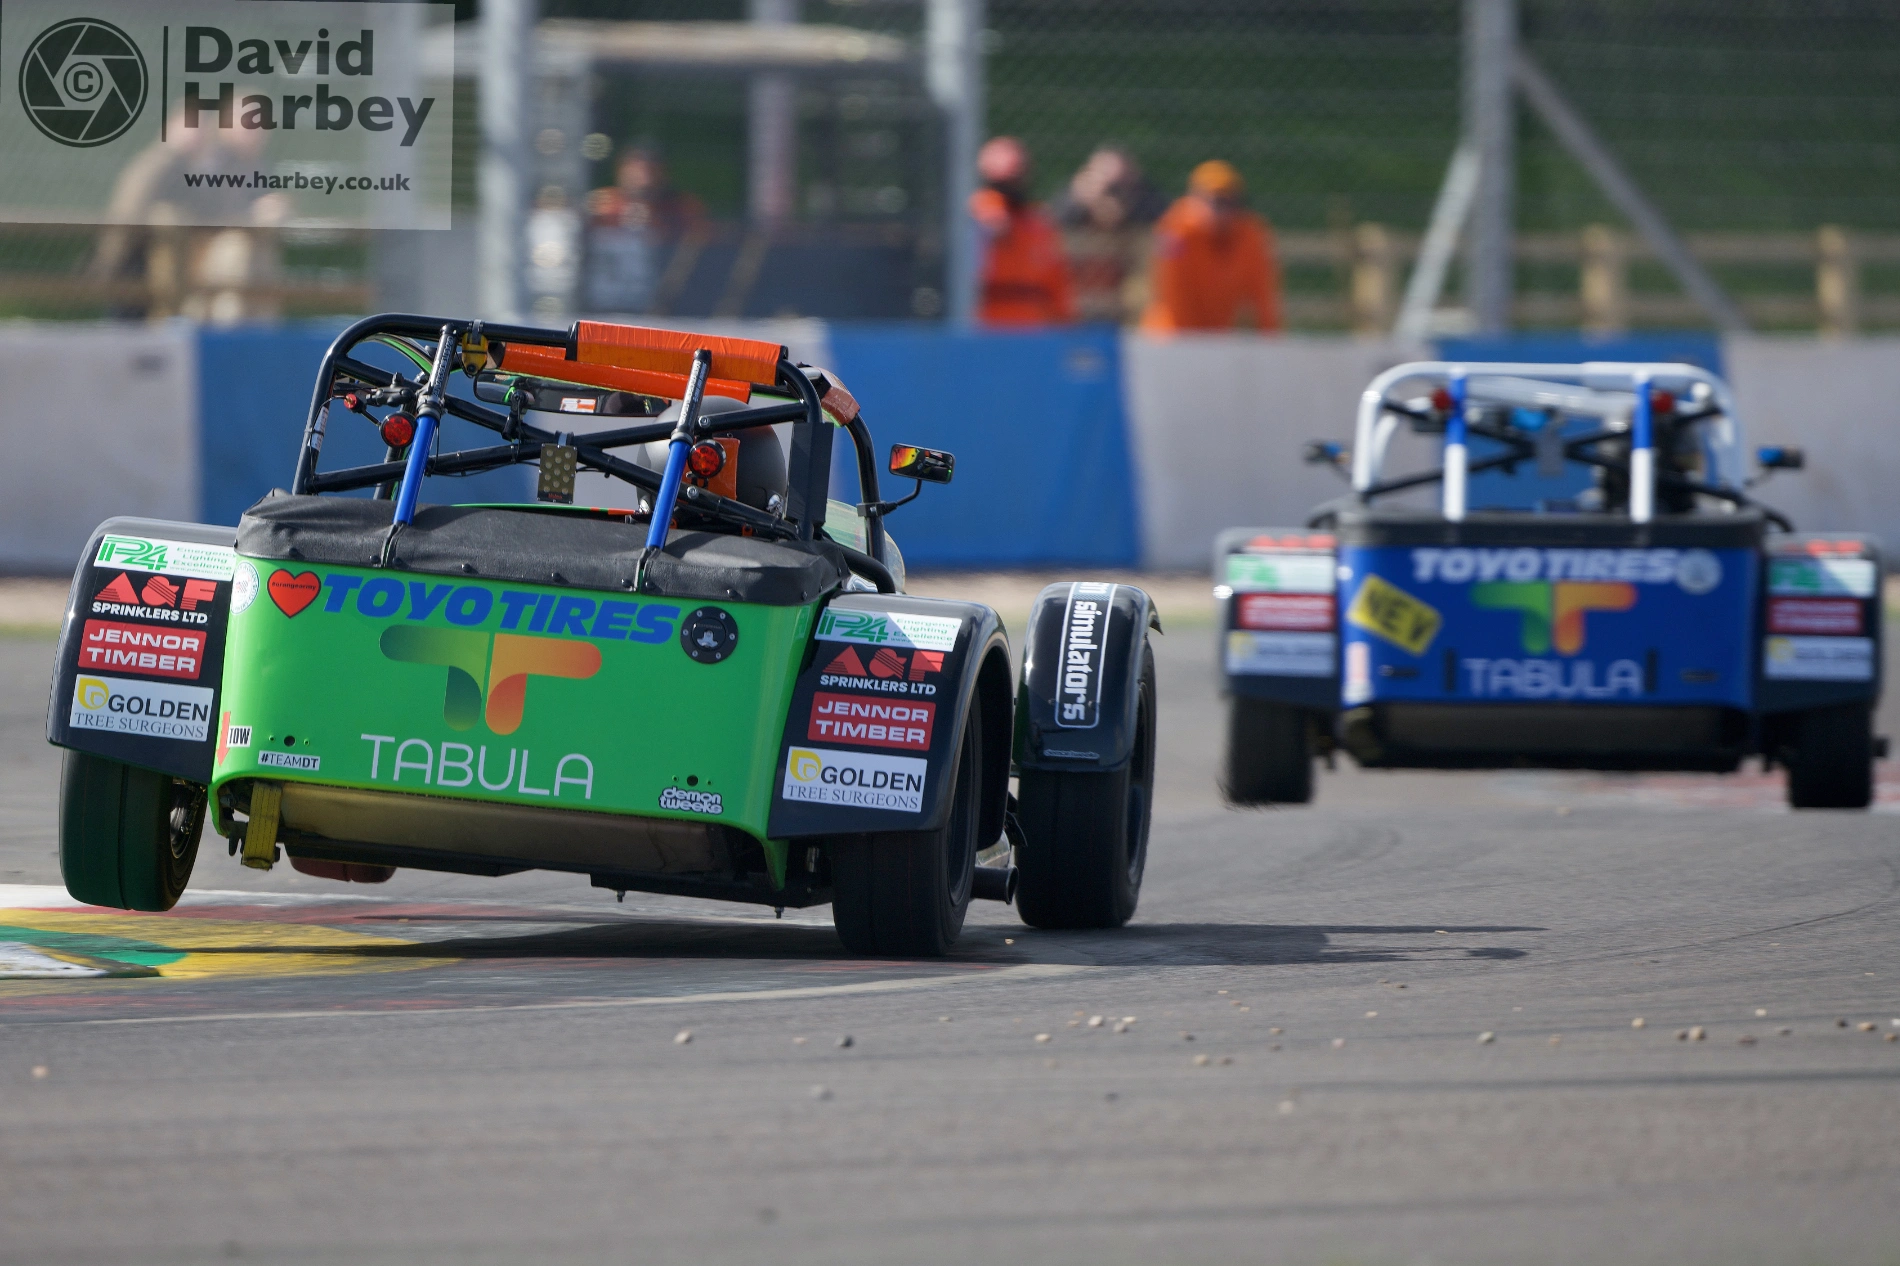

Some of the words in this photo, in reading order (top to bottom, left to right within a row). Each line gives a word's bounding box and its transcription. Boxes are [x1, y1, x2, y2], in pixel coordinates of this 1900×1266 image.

[98, 536, 168, 571] P4
[177, 547, 236, 558] Emergency
[182, 554, 228, 564] Lighting
[173, 560, 232, 570] Excellence
[94, 571, 218, 611] A&F
[272, 581, 317, 591] #orangearmy
[92, 602, 180, 621] SPRINKLERS
[181, 611, 208, 624] LTD
[896, 618, 957, 629] Emergency
[817, 609, 889, 643] P4
[893, 631, 953, 641] Excellence
[903, 625, 948, 635] Lighting
[89, 628, 200, 652] JENNOR
[87, 647, 196, 673] TIMBER
[822, 645, 945, 682] A&F
[1063, 600, 1102, 721] simulators
[820, 675, 908, 693] SPRINKLERS
[910, 682, 937, 695] LTD
[1463, 657, 1645, 698] TABULA
[108, 694, 209, 722] GOLDEN
[818, 700, 929, 723] JENNOR
[75, 712, 115, 729] TREE
[118, 717, 205, 739] SURGEONS
[229, 727, 251, 745] TOW
[815, 719, 926, 745] TIMBER
[260, 752, 319, 769] #TEAMDT
[361, 733, 594, 800] TABULA
[820, 766, 922, 793] GOLDEN
[659, 795, 723, 815] tweeks
[662, 786, 722, 805] demon
[788, 785, 828, 801] TREE
[831, 789, 919, 810] SURGEONS
